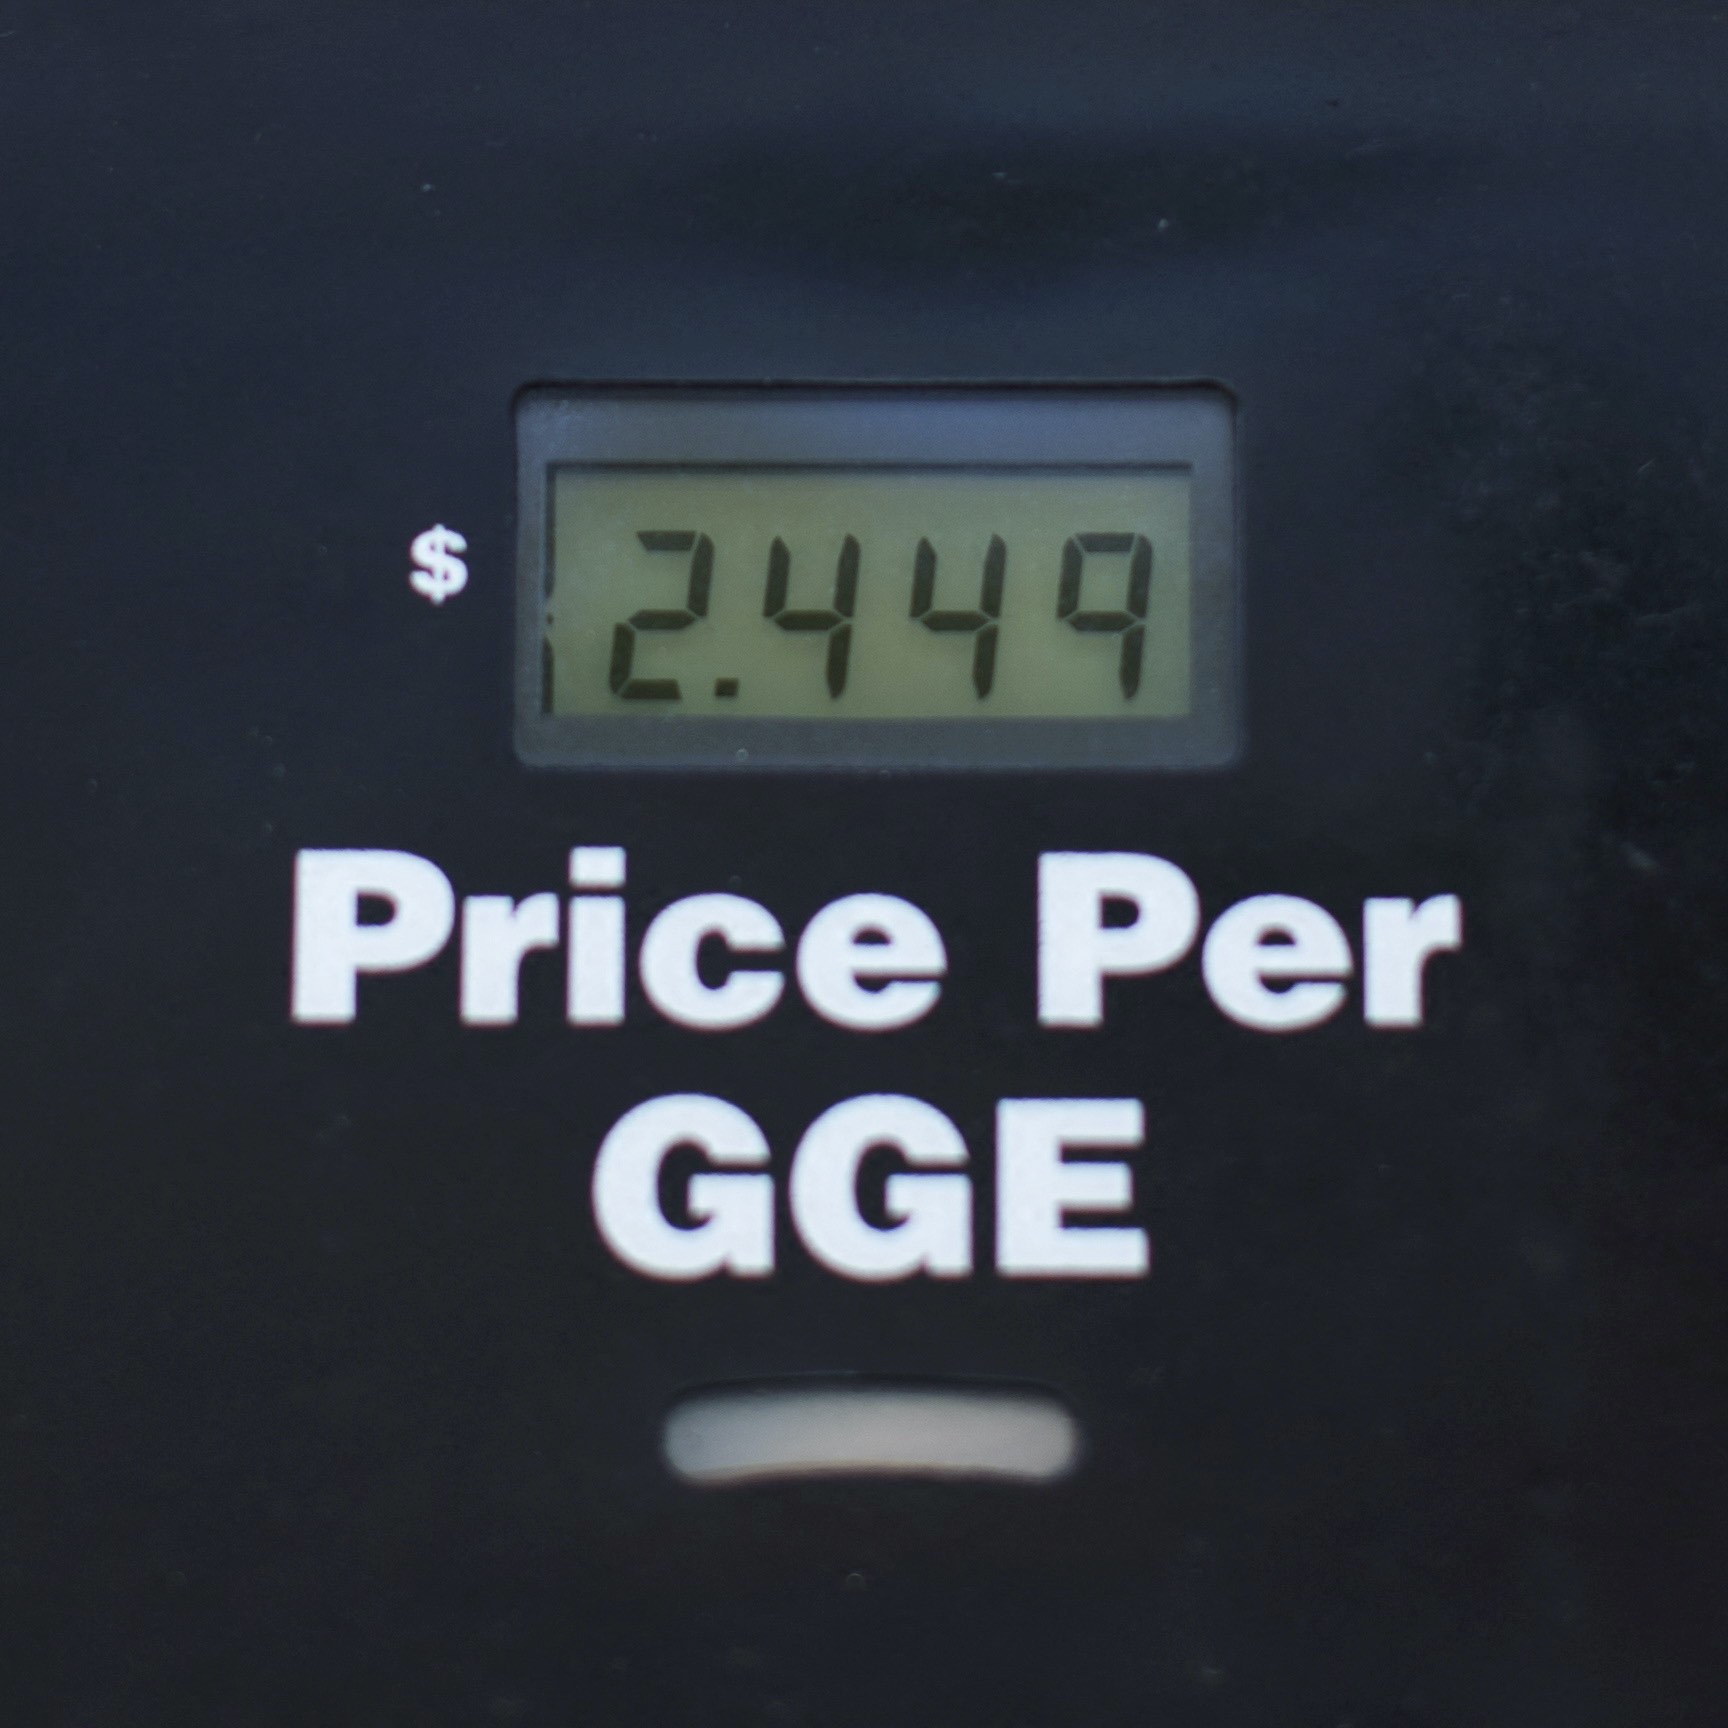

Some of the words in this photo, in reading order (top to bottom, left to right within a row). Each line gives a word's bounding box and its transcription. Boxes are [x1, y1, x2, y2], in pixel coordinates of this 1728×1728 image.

[411, 525, 467, 602] $
[606, 530, 1153, 700] 2.449
[293, 847, 946, 1029] Price
[1038, 852, 1460, 1029] Per
[593, 1094, 1148, 1279] GGE
